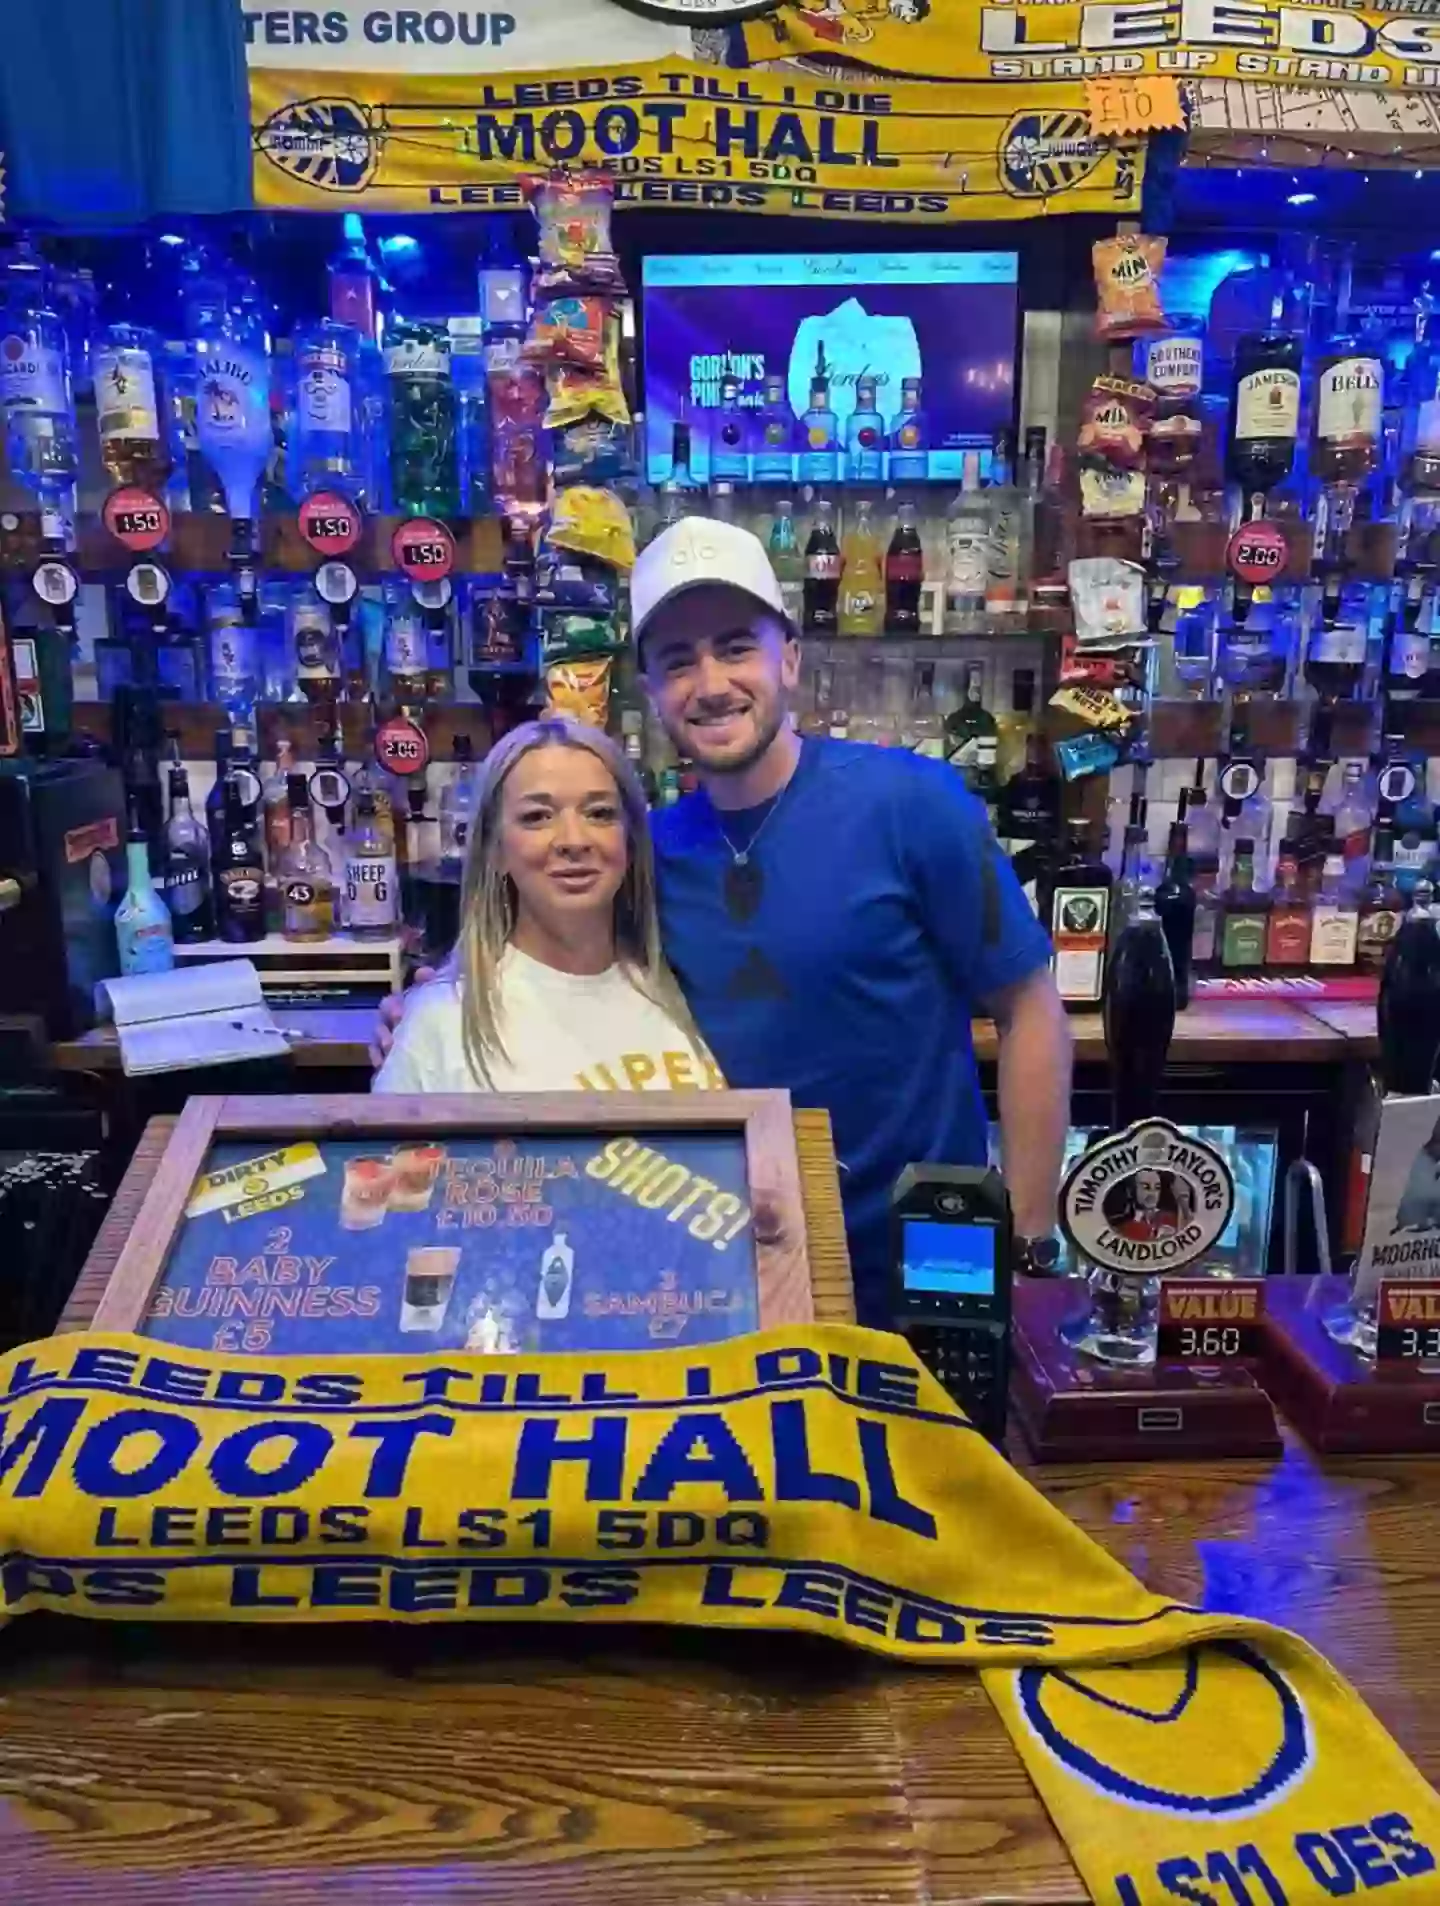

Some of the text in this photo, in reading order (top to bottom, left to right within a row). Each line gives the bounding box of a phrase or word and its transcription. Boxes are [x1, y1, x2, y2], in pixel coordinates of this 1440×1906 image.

[363, 11, 516, 45] GROUP
[981, 0, 1440, 62] LEEDS
[991, 52, 1143, 77] STAND
[1157, 51, 1218, 70] UP
[1236, 52, 1393, 84] STAND
[483, 73, 892, 112] LEEDS TILL I DIE
[1099, 91, 1152, 122] £10
[475, 104, 900, 168] MOOT HALL
[562, 155, 816, 183] EEDS LS1 5DQ
[430, 182, 949, 213] LEE LEEDS LEEDS
[123, 512, 160, 532] 1.50
[314, 518, 350, 537] 1.50
[410, 544, 445, 564] 1.50
[1237, 547, 1281, 566] 2.00
[346, 863, 386, 882] SHEEP
[207, 1150, 288, 1188] DIRTY
[1075, 1144, 1223, 1216] TIMOTHY TAYLOR'S
[224, 1184, 305, 1224] LEEDS
[585, 1136, 752, 1251] SHOTS!
[263, 1226, 293, 1255] 2
[1096, 1224, 1203, 1262] LANDLORD
[205, 1256, 337, 1286] BABY
[146, 1285, 382, 1317] GUINNESS
[1167, 1294, 1258, 1320] VALUE
[211, 1319, 274, 1351] £5
[1180, 1327, 1240, 1357] 3.60
[8, 1348, 365, 1405] LEEDS
[403, 1367, 638, 1402] TILL
[687, 1367, 711, 1397] I
[755, 1347, 920, 1406] DIE
[0, 1396, 938, 1540] MOOT HALL
[94, 1504, 770, 1551] LEEDS LS1 5DQ
[230, 1565, 641, 1613] LEEDS
[700, 1564, 1056, 1648] LEEDS
